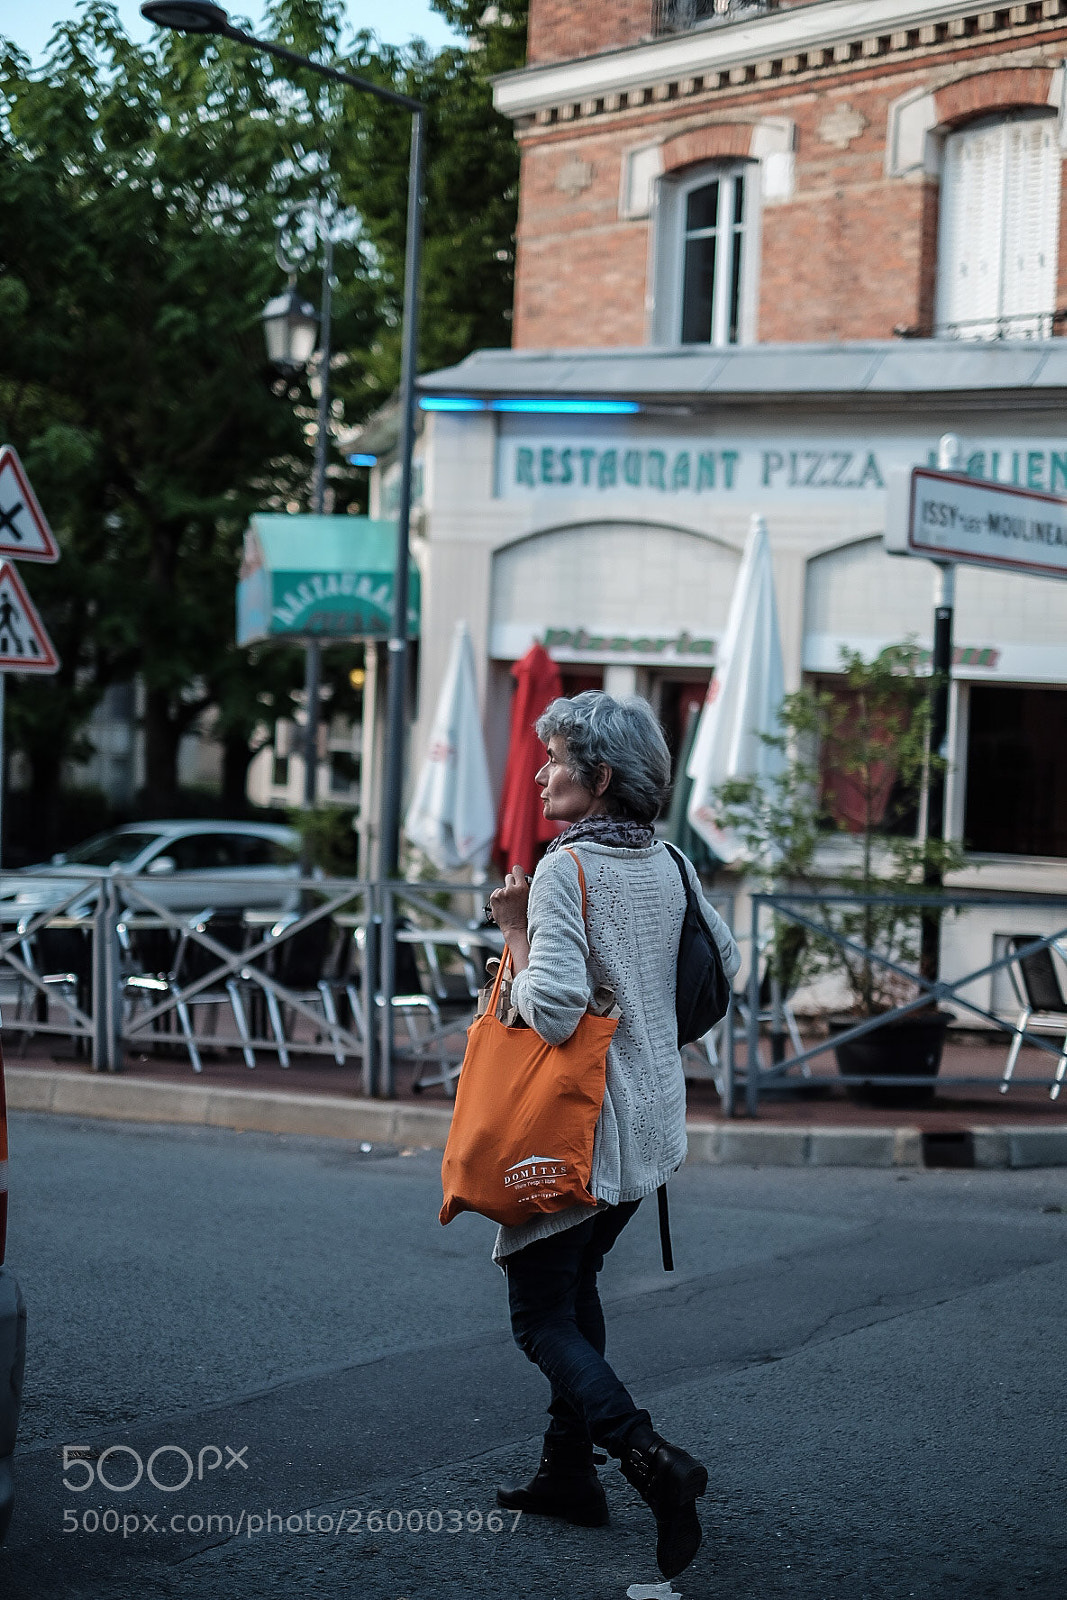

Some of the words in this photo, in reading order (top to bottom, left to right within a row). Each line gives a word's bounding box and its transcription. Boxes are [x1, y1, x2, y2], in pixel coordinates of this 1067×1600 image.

[515, 446, 739, 492] RESTAURANT
[760, 449, 886, 488] PIZZA
[928, 450, 1067, 492] ALIEN
[504, 1165, 567, 1185] DOMITYS
